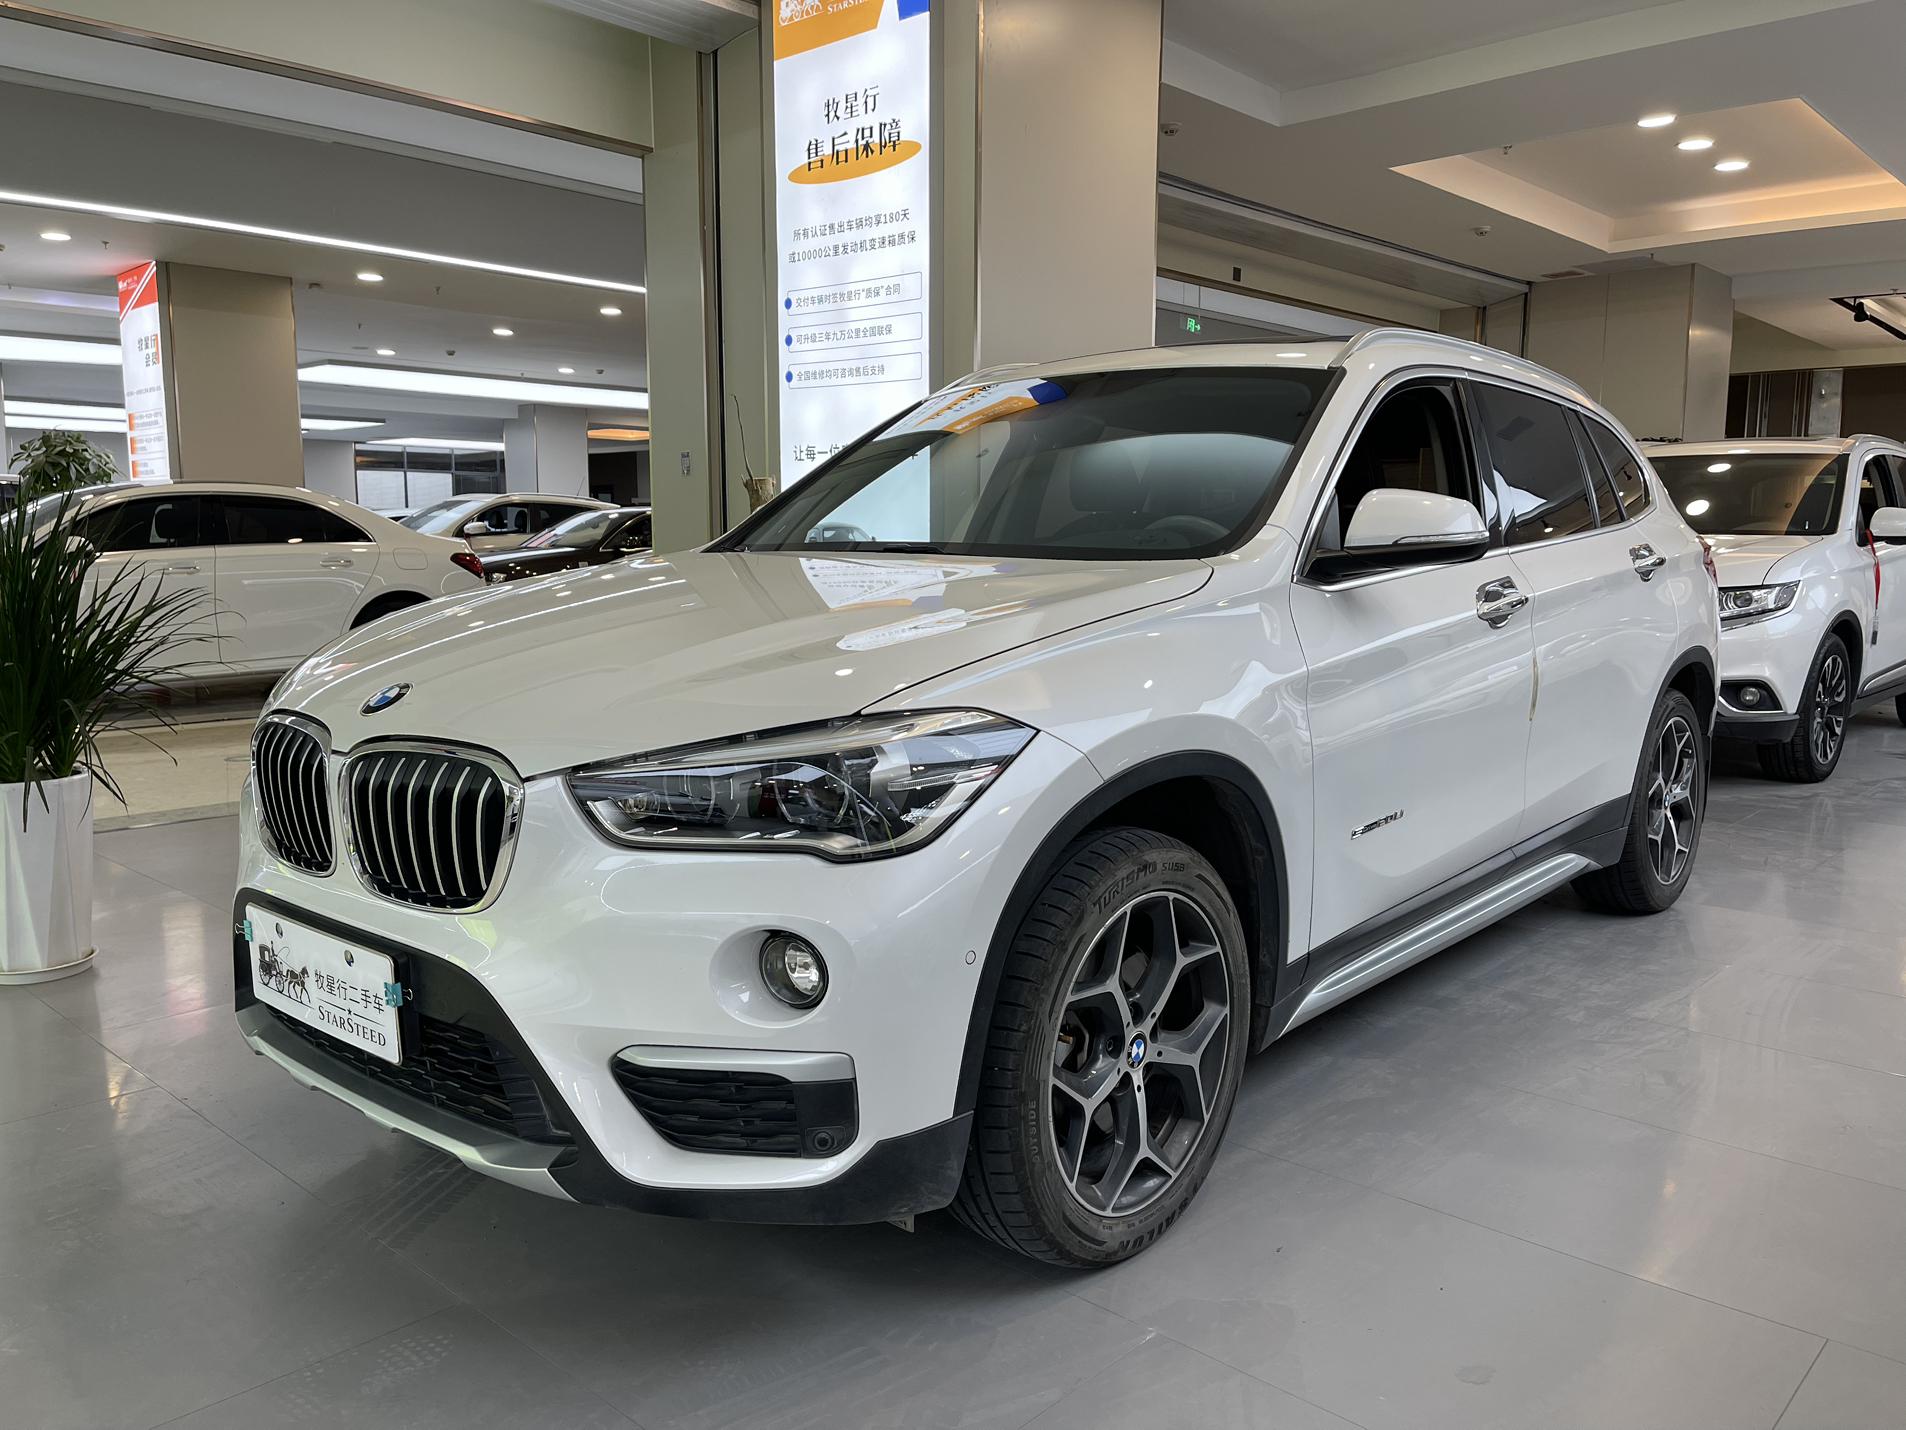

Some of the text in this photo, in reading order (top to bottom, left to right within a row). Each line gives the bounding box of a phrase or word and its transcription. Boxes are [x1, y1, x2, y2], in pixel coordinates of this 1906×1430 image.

[823, 85, 880, 125] 牧星行
[805, 118, 902, 172] 售后保障
[793, 208, 910, 242] 所有认证售出车辆均享180天
[788, 230, 917, 264] 或10000公里发动机变速箱质保
[796, 324, 893, 345] 可升级三年九万公里全国联保
[797, 364, 885, 382] 全国维修均可咨询售后支持
[314, 968, 385, 1015] 牧星行二手车
[318, 1005, 386, 1047] STARSTEED
